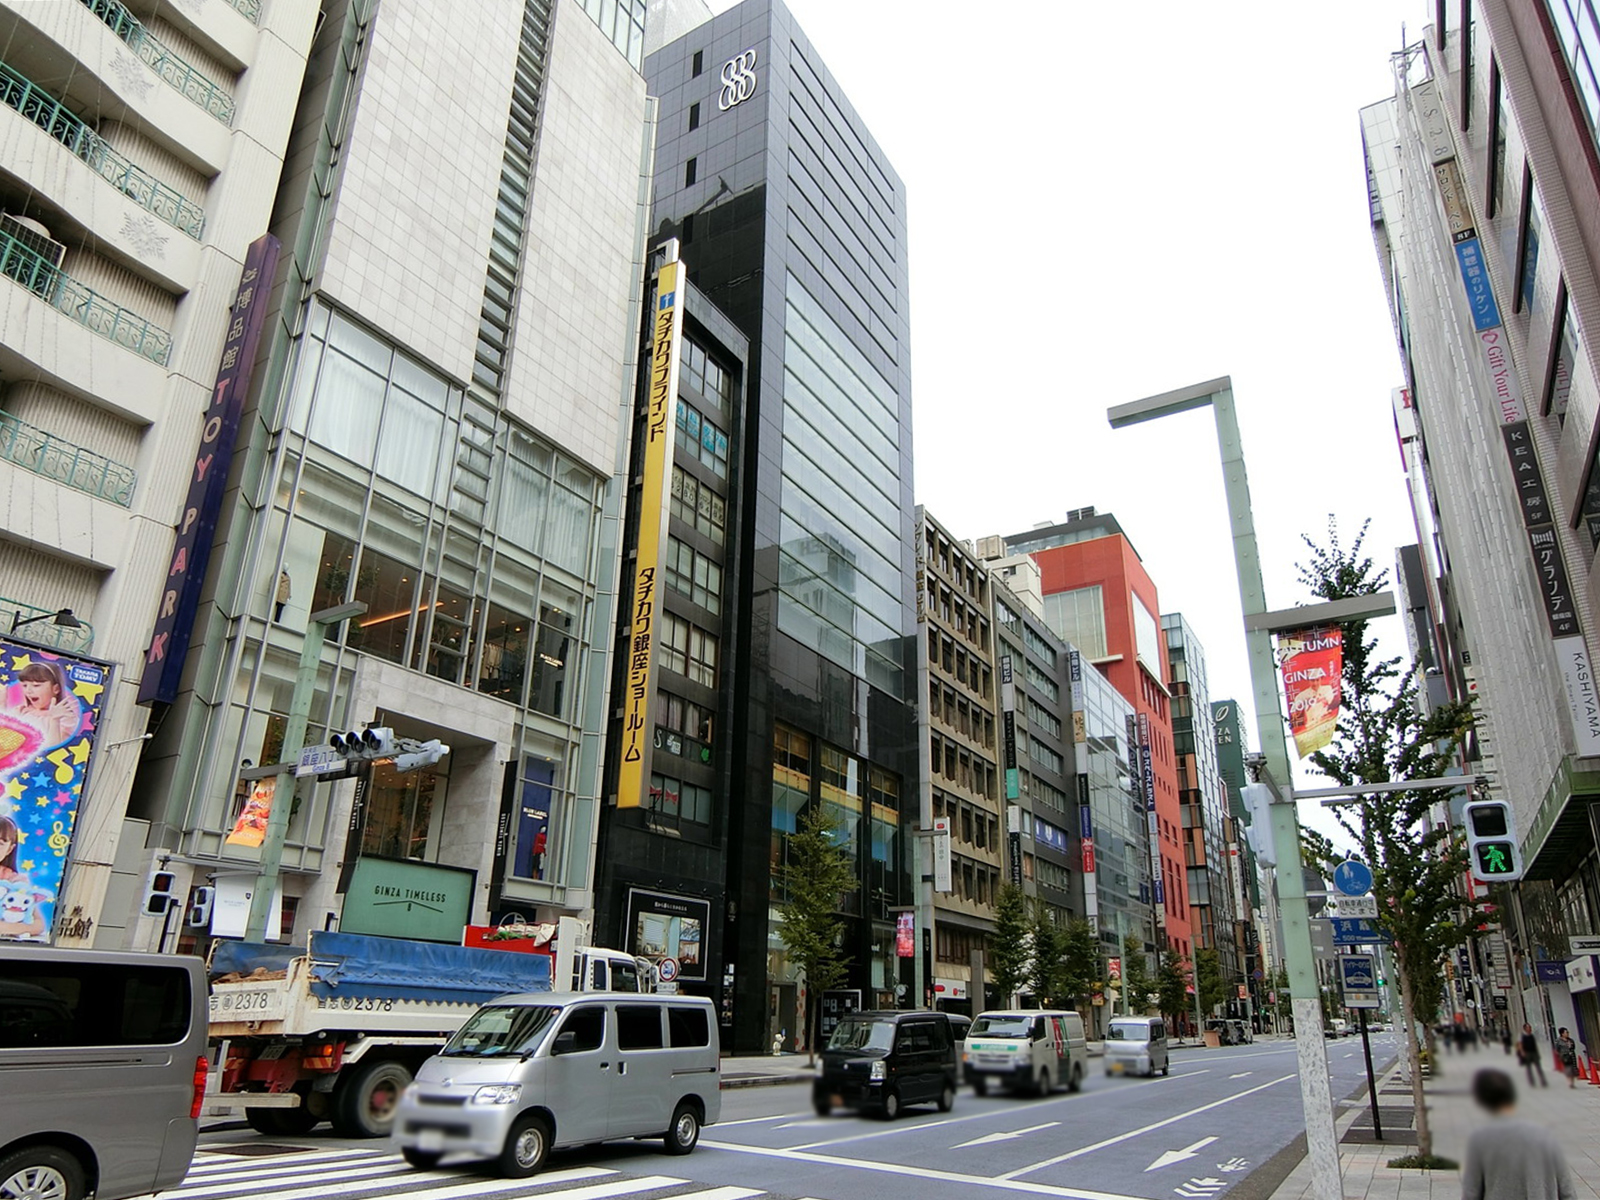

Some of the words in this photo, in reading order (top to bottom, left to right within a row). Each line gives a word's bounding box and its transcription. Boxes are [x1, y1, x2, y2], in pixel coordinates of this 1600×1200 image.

[222, 286, 253, 373] 博品館
[1487, 345, 1506, 369] Gift
[649, 310, 674, 443] タチカワブラインド
[1493, 369, 1509, 397] Your
[1500, 398, 1520, 423] Life
[196, 377, 229, 483] TOY
[148, 507, 198, 664] PARK
[1538, 549, 1565, 612] グランデ
[624, 566, 656, 762] タチカワ銀座ショールーム
[1283, 668, 1327, 684] GINZA
[1573, 652, 1600, 738] KASHIYAMA
[301, 751, 341, 767] 銀座八丁
[374, 885, 401, 898] GINZA
[405, 889, 447, 903] TIMELESS
[1340, 907, 1376, 916] ここまで
[234, 992, 269, 1010] 2378
[354, 996, 394, 1012] 2378
